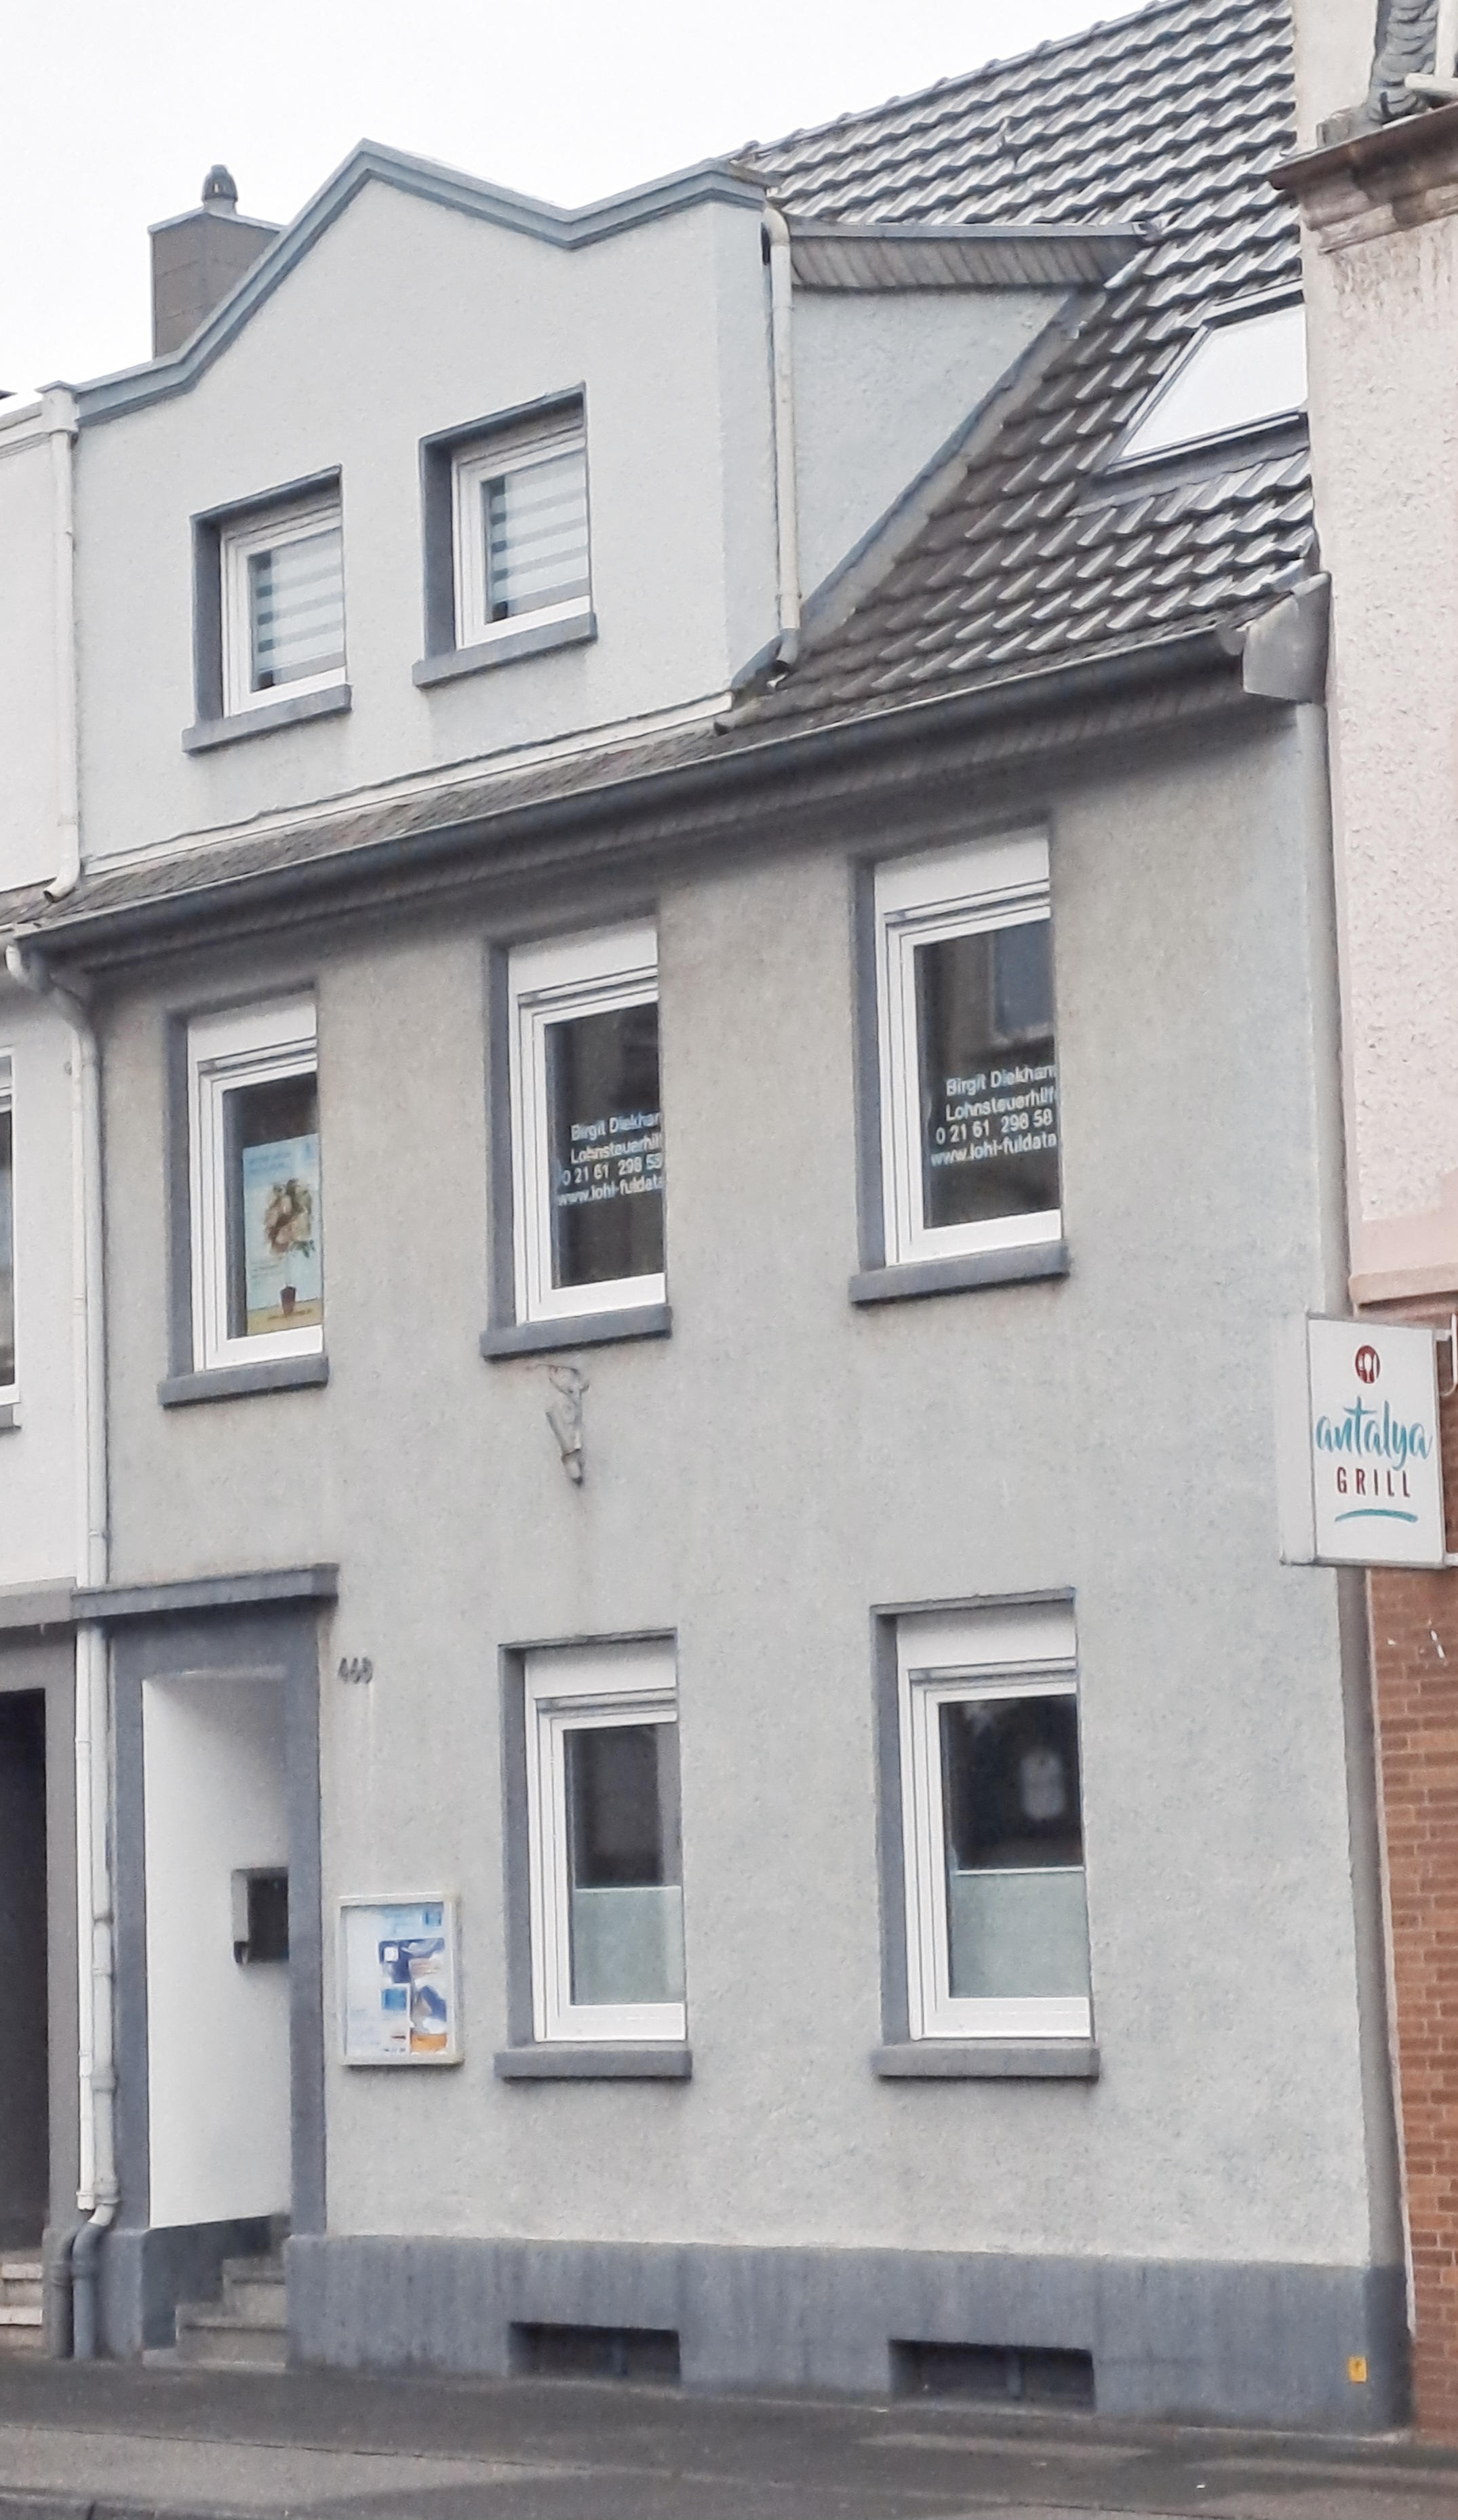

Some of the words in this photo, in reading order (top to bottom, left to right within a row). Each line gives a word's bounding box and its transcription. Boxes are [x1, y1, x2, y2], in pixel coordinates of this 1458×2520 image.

[946, 1073, 986, 1096] Birgit
[570, 1120, 606, 1141] Birgit
[936, 1127, 946, 1145] 0
[950, 1123, 966, 1142] 21
[972, 1119, 990, 1138] 61
[574, 1166, 589, 1184] 21
[593, 1162, 610, 1180] 61
[1316, 1395, 1432, 1471] antalya
[1336, 1466, 1411, 1498] GRILL
